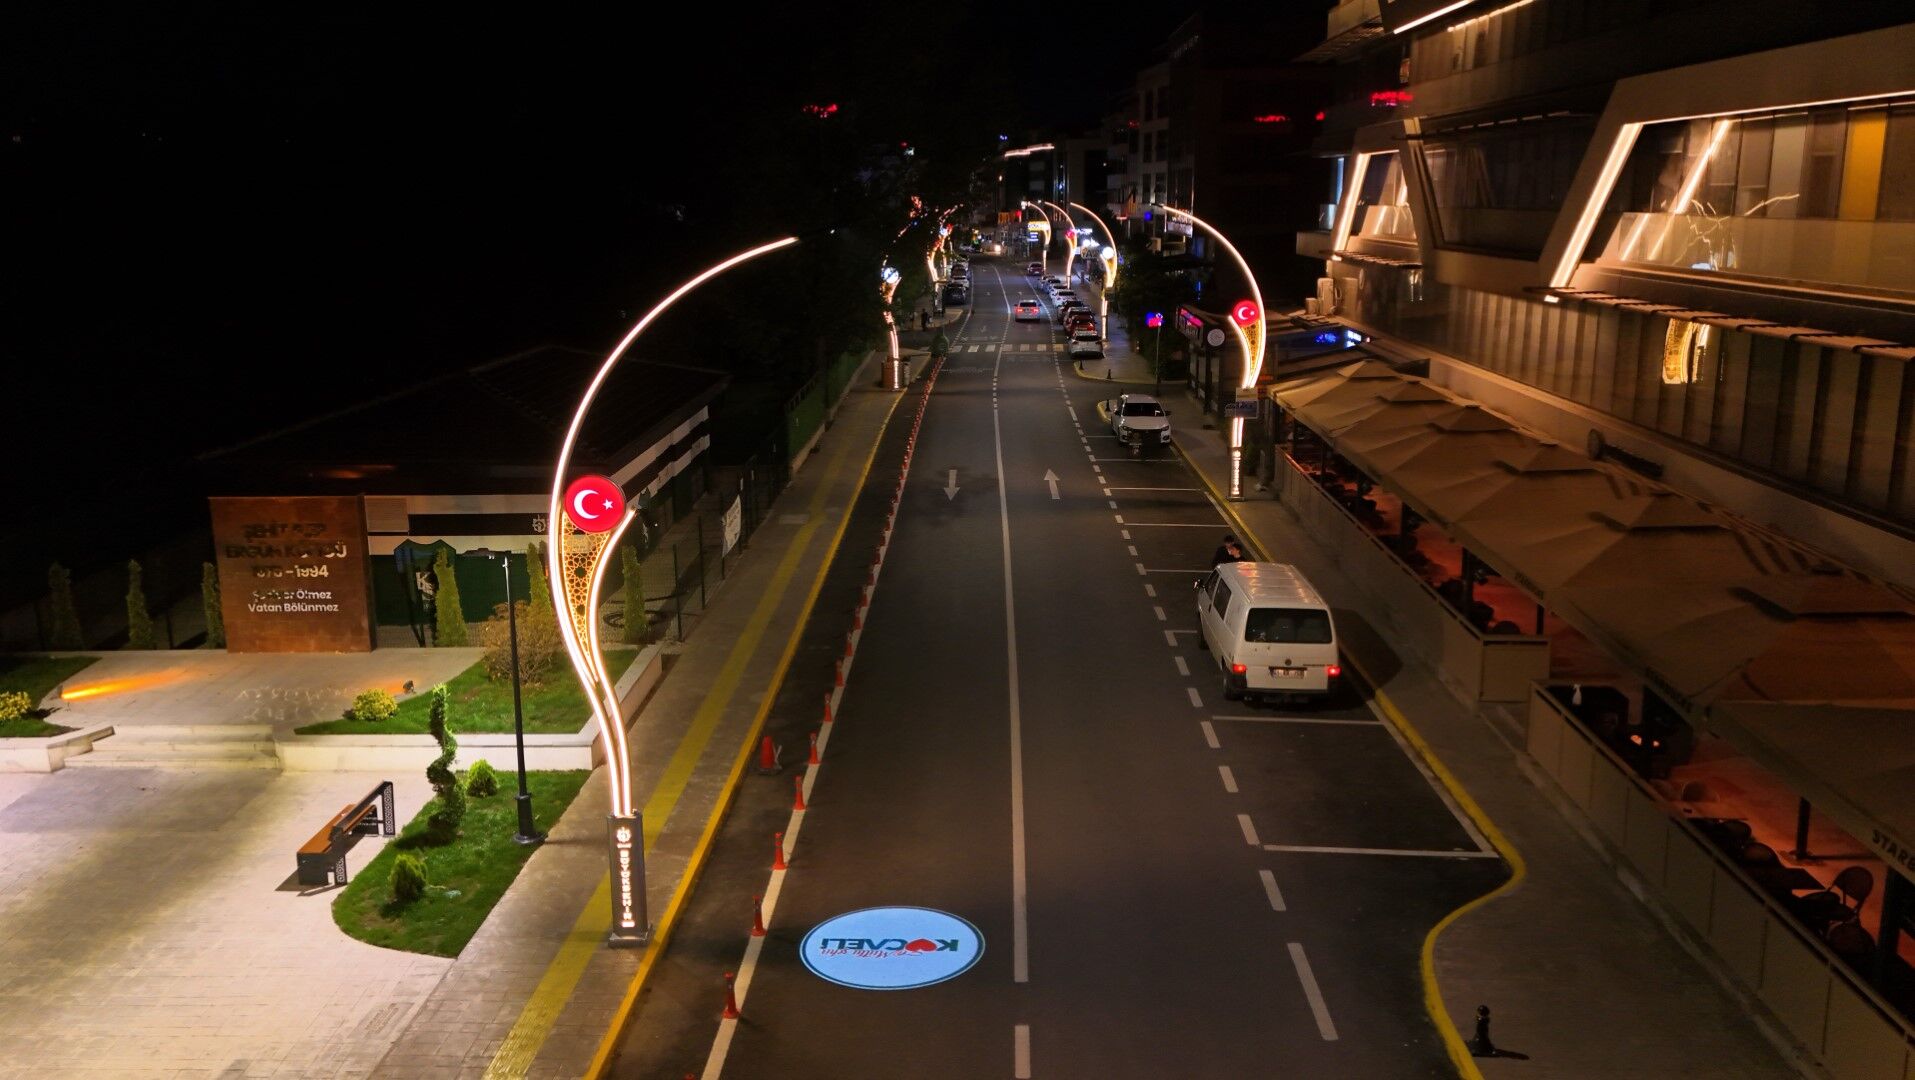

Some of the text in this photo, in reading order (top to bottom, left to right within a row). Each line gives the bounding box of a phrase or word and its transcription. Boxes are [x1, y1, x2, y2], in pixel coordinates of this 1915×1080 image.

[294, 564, 329, 578] 1994
[296, 588, 332, 600] Ölmez
[248, 602, 339, 613] Vatan Bölünmez
